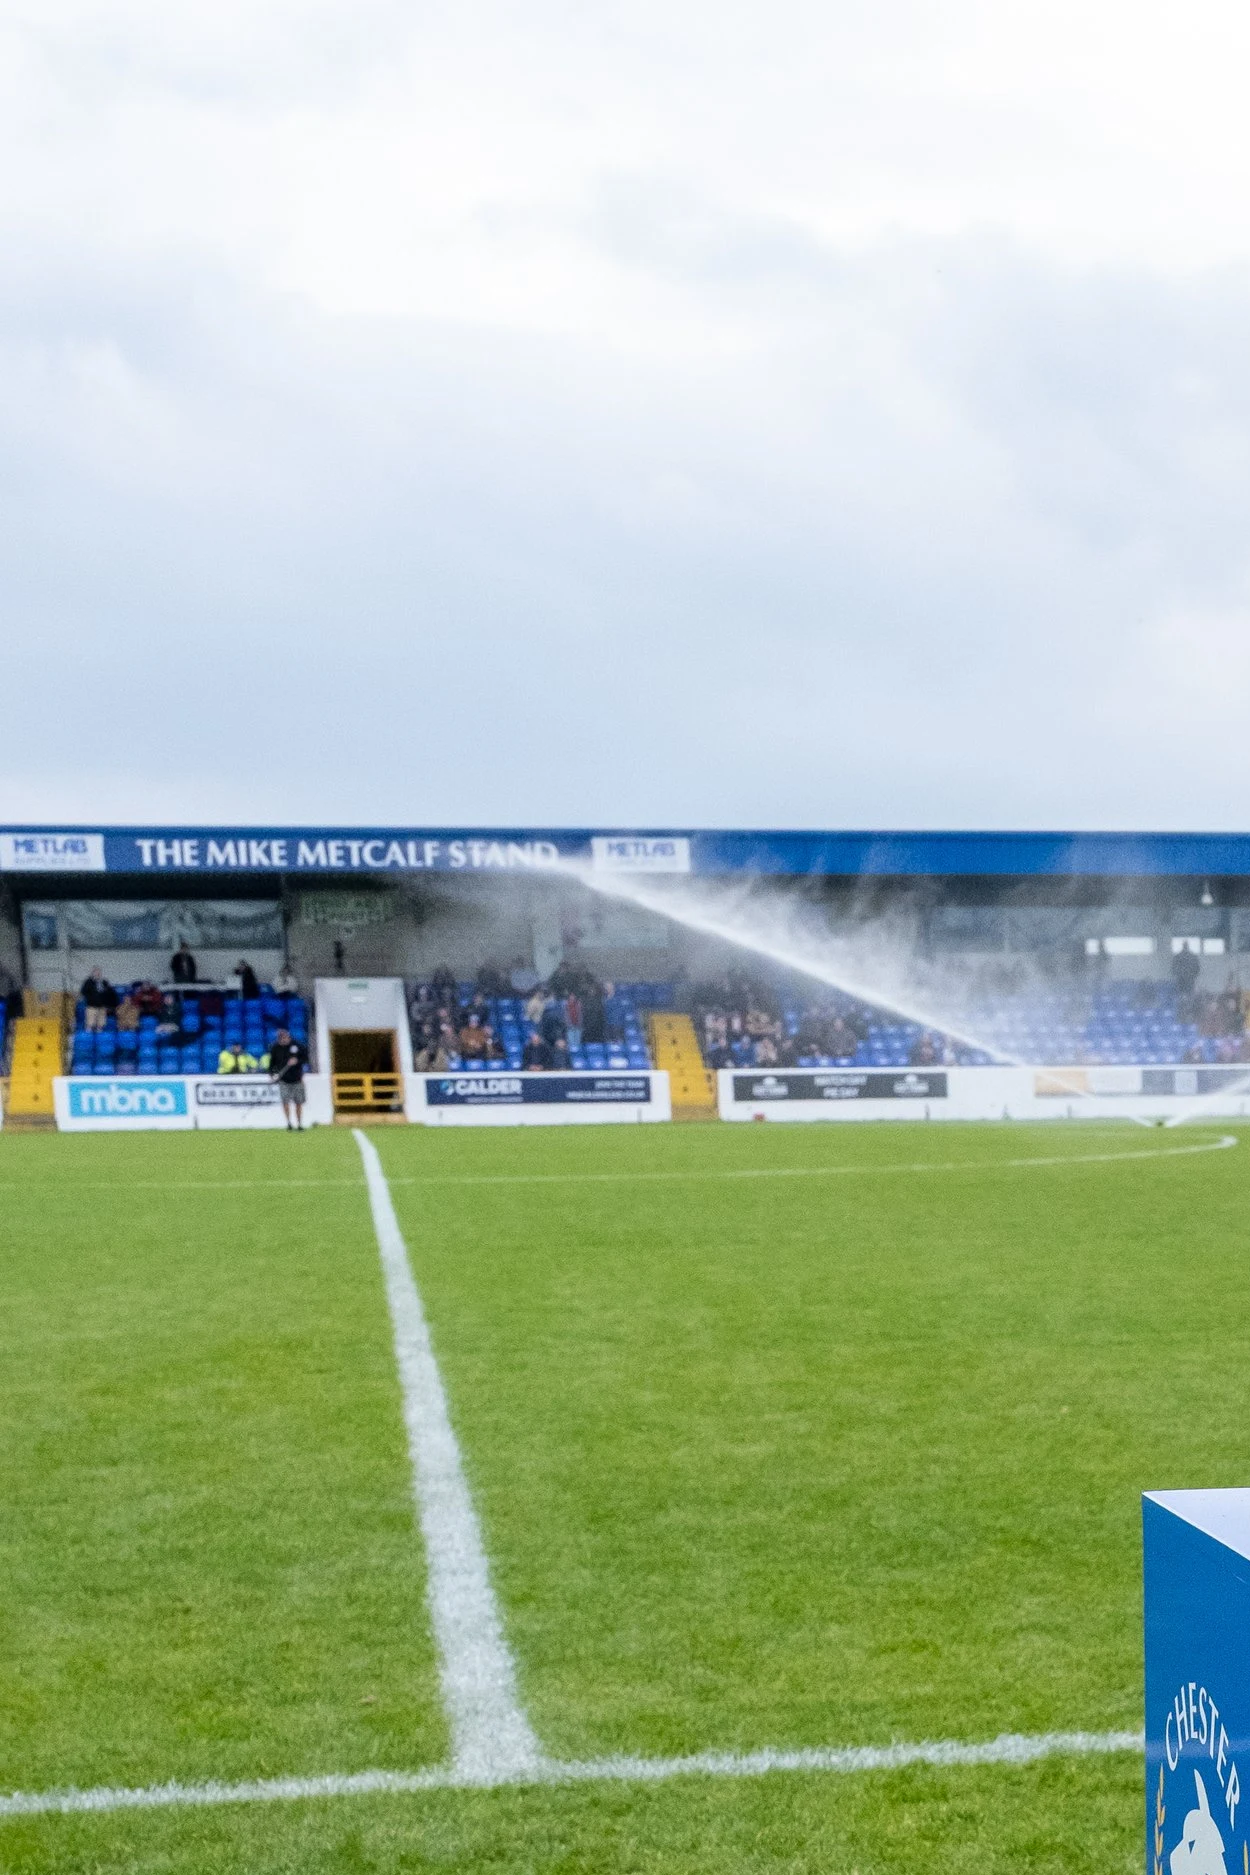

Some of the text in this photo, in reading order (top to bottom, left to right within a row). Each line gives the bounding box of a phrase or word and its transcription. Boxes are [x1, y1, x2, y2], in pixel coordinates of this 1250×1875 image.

[14, 838, 87, 853] METLAB
[135, 839, 558, 868] THE MIKE METCALF STAND
[80, 1084, 176, 1113] mbna
[456, 1079, 522, 1095] CALDER
[1165, 1682, 1240, 1831] CHESTER
